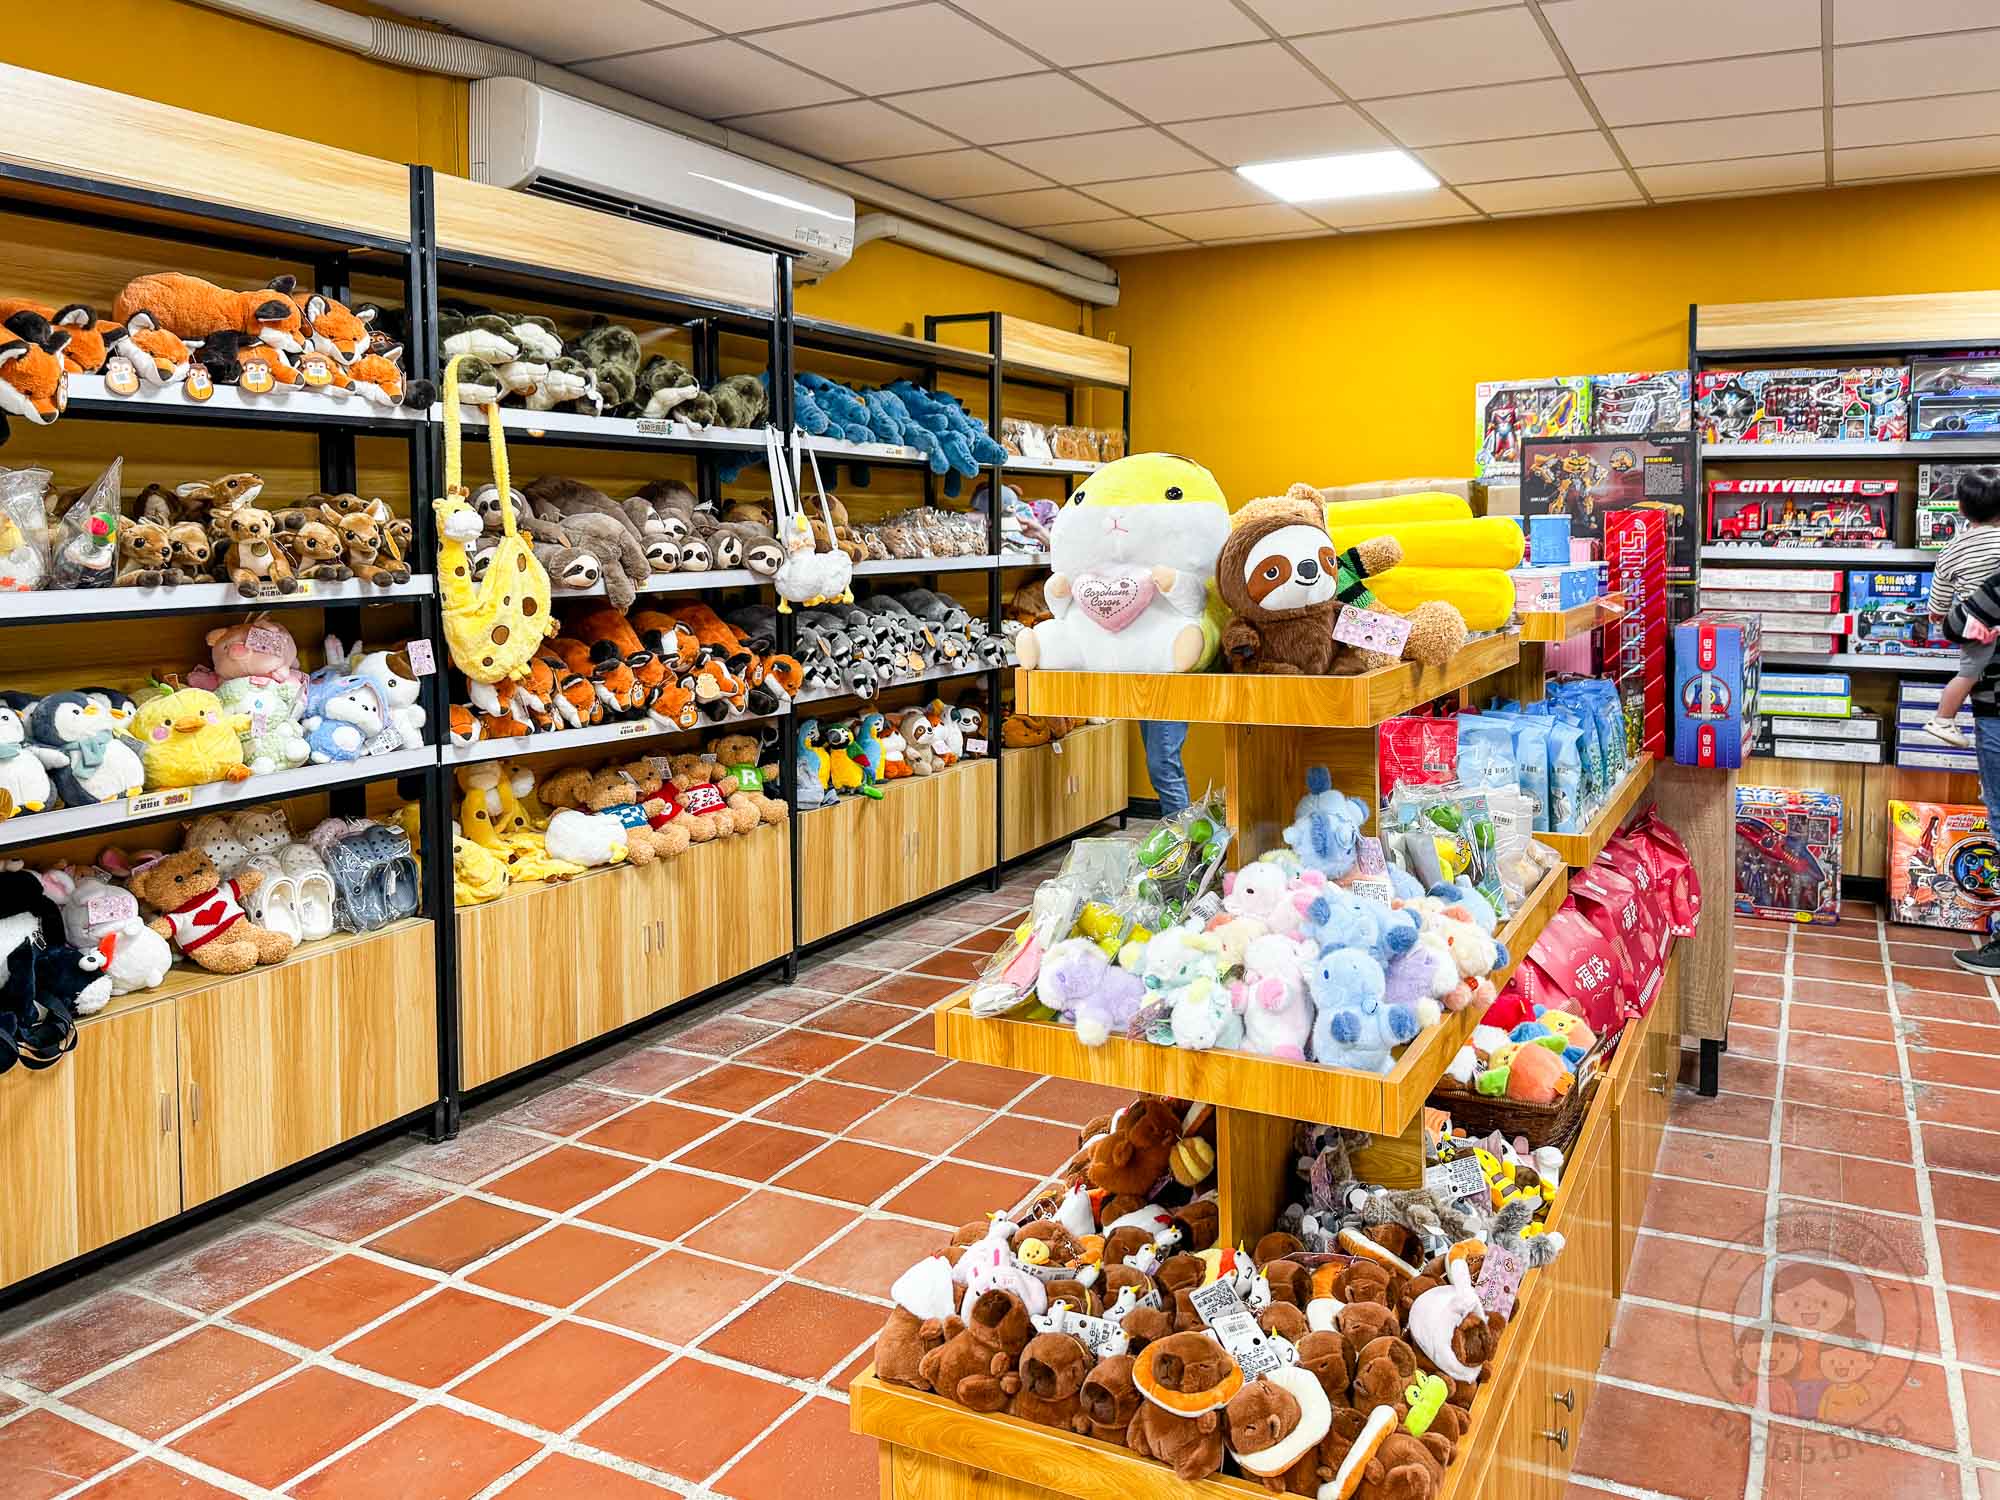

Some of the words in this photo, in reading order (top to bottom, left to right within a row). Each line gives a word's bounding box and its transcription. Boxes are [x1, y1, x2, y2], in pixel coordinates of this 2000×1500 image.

[1739, 480, 1781, 492] CITY
[1782, 480, 1854, 492] VEHICLE
[741, 769, 758, 785] R
[1575, 954, 1610, 991] 福袋
